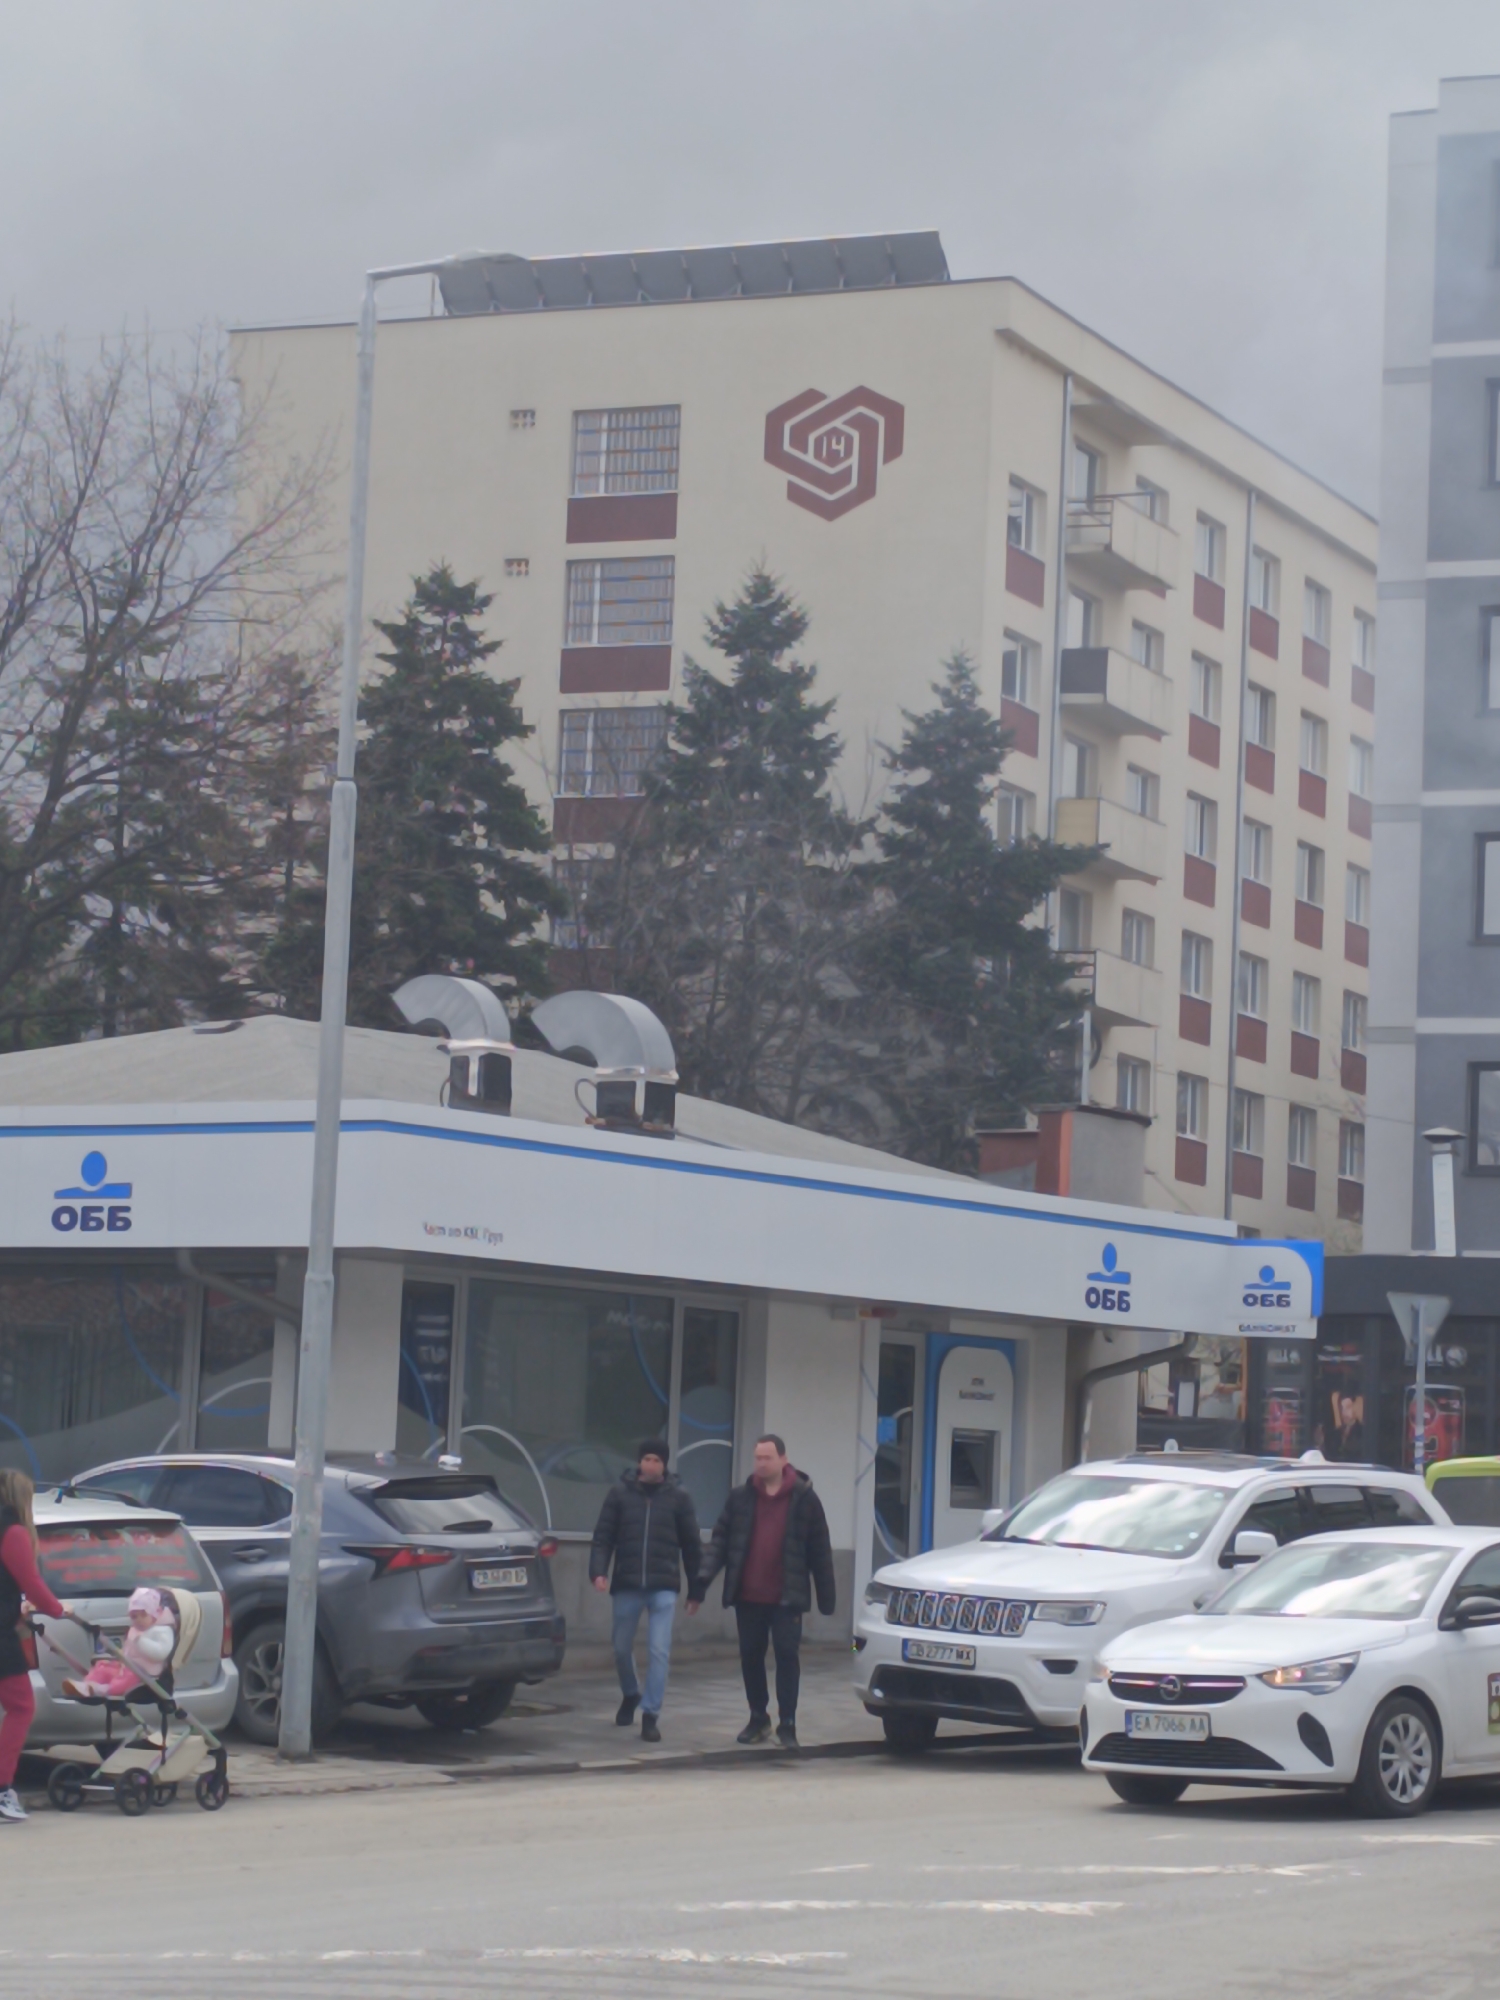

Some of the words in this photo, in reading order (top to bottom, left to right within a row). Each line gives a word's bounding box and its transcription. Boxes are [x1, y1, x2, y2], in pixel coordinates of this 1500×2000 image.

[822, 436, 845, 459] 14
[51, 1205, 132, 1232] ОББ
[1085, 1286, 1132, 1313] ОББ
[1242, 1293, 1292, 1308] ОББ
[1134, 1714, 1152, 1731] EA
